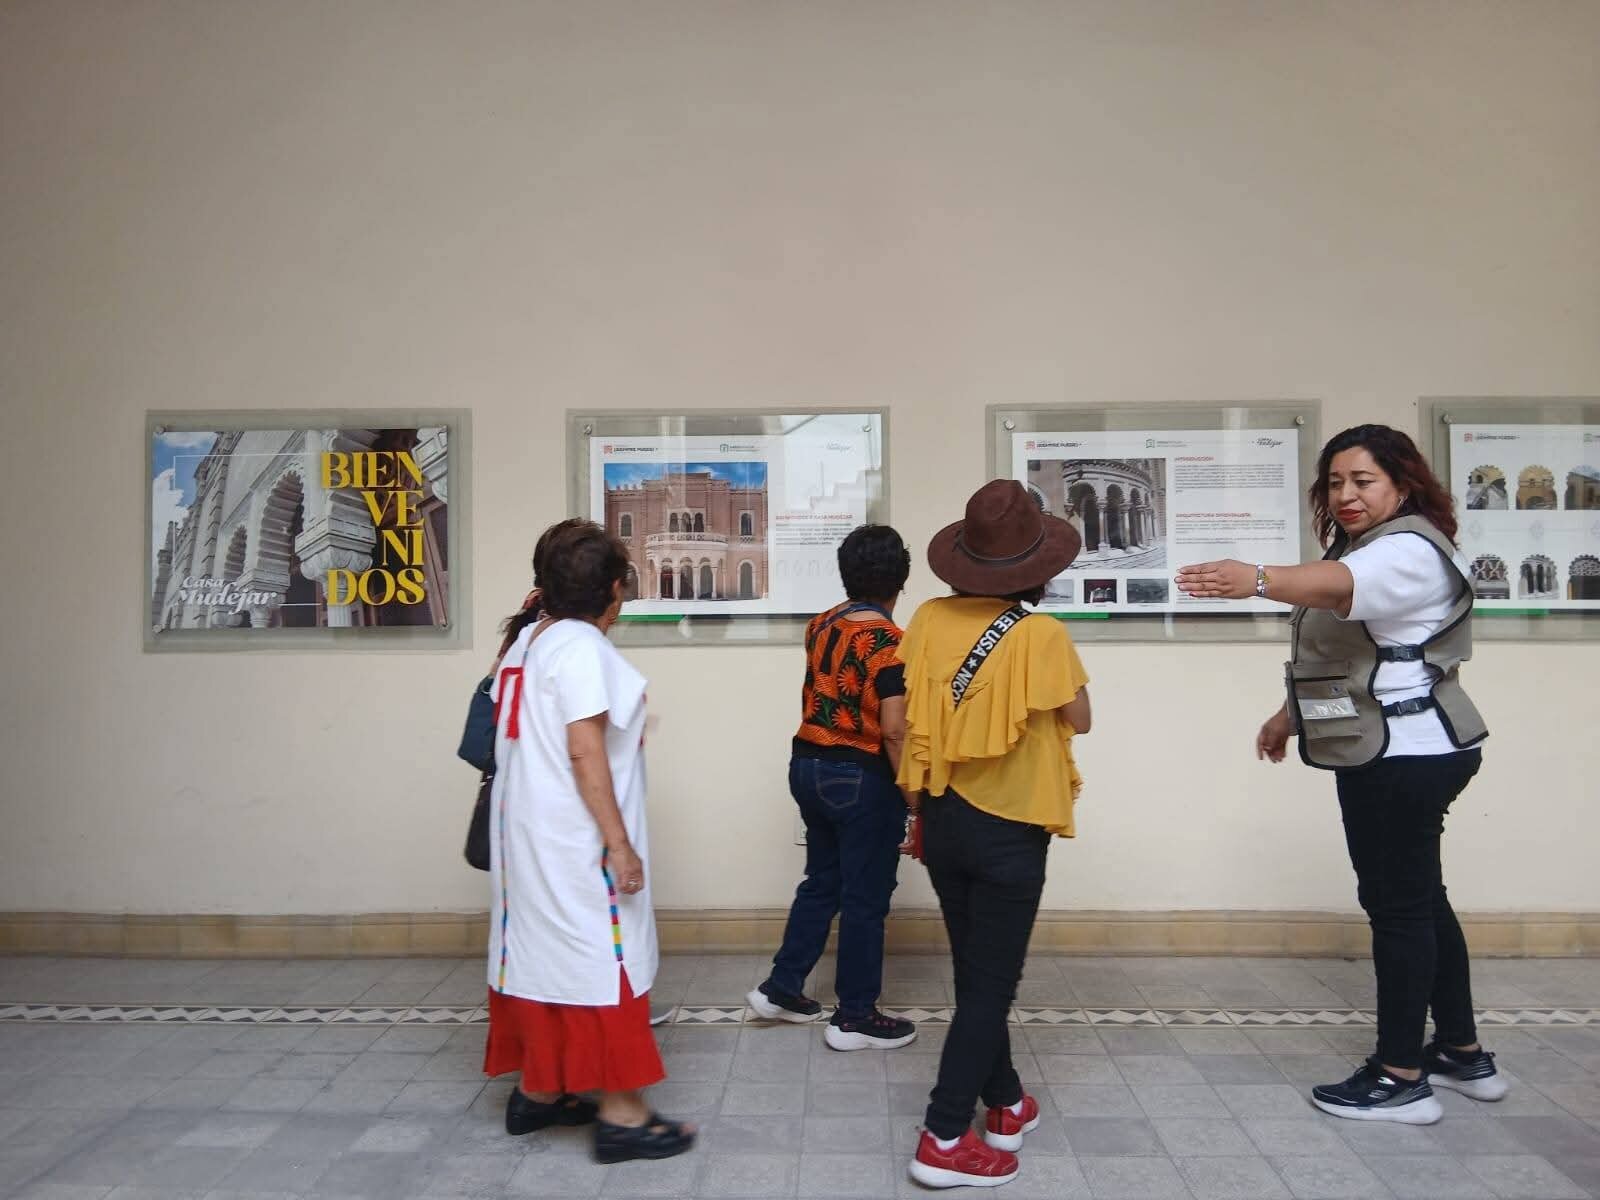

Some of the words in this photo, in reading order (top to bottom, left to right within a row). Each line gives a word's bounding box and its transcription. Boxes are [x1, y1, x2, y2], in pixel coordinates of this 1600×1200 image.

[321, 451, 423, 489] BIEN
[361, 490, 425, 527] VE
[381, 529, 425, 566] NI
[182, 575, 225, 589] Casa
[327, 568, 425, 606] DOS
[993, 611, 1020, 632] LEE
[972, 629, 1001, 657] USA
